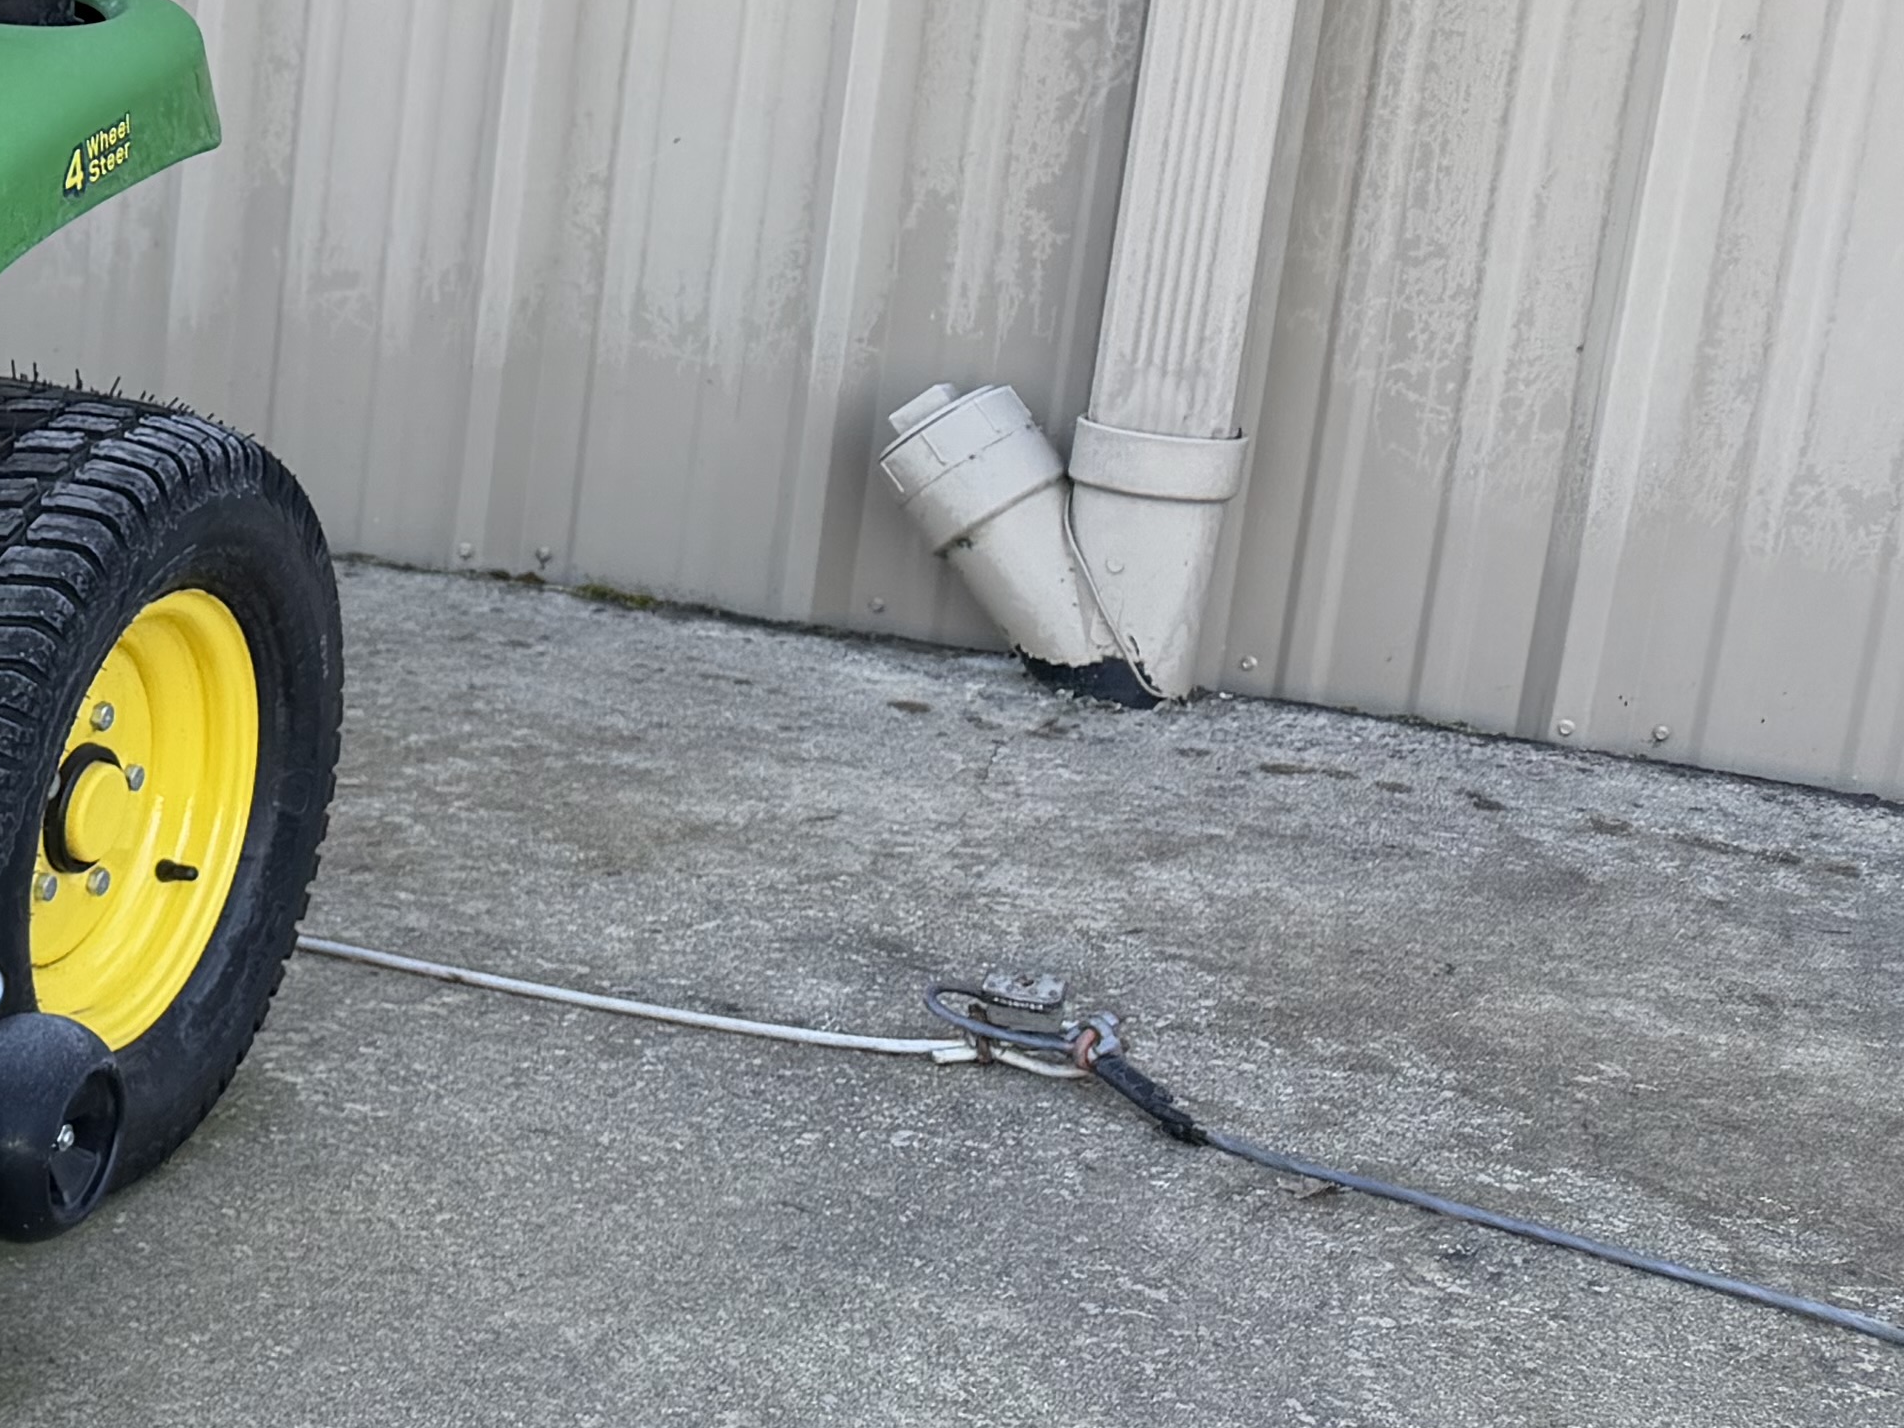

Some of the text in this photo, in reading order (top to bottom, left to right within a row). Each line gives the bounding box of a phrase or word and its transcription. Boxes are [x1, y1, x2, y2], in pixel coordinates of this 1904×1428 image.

[85, 112, 131, 161] Wheel
[62, 145, 86, 195] 4
[88, 140, 132, 184] Steer
